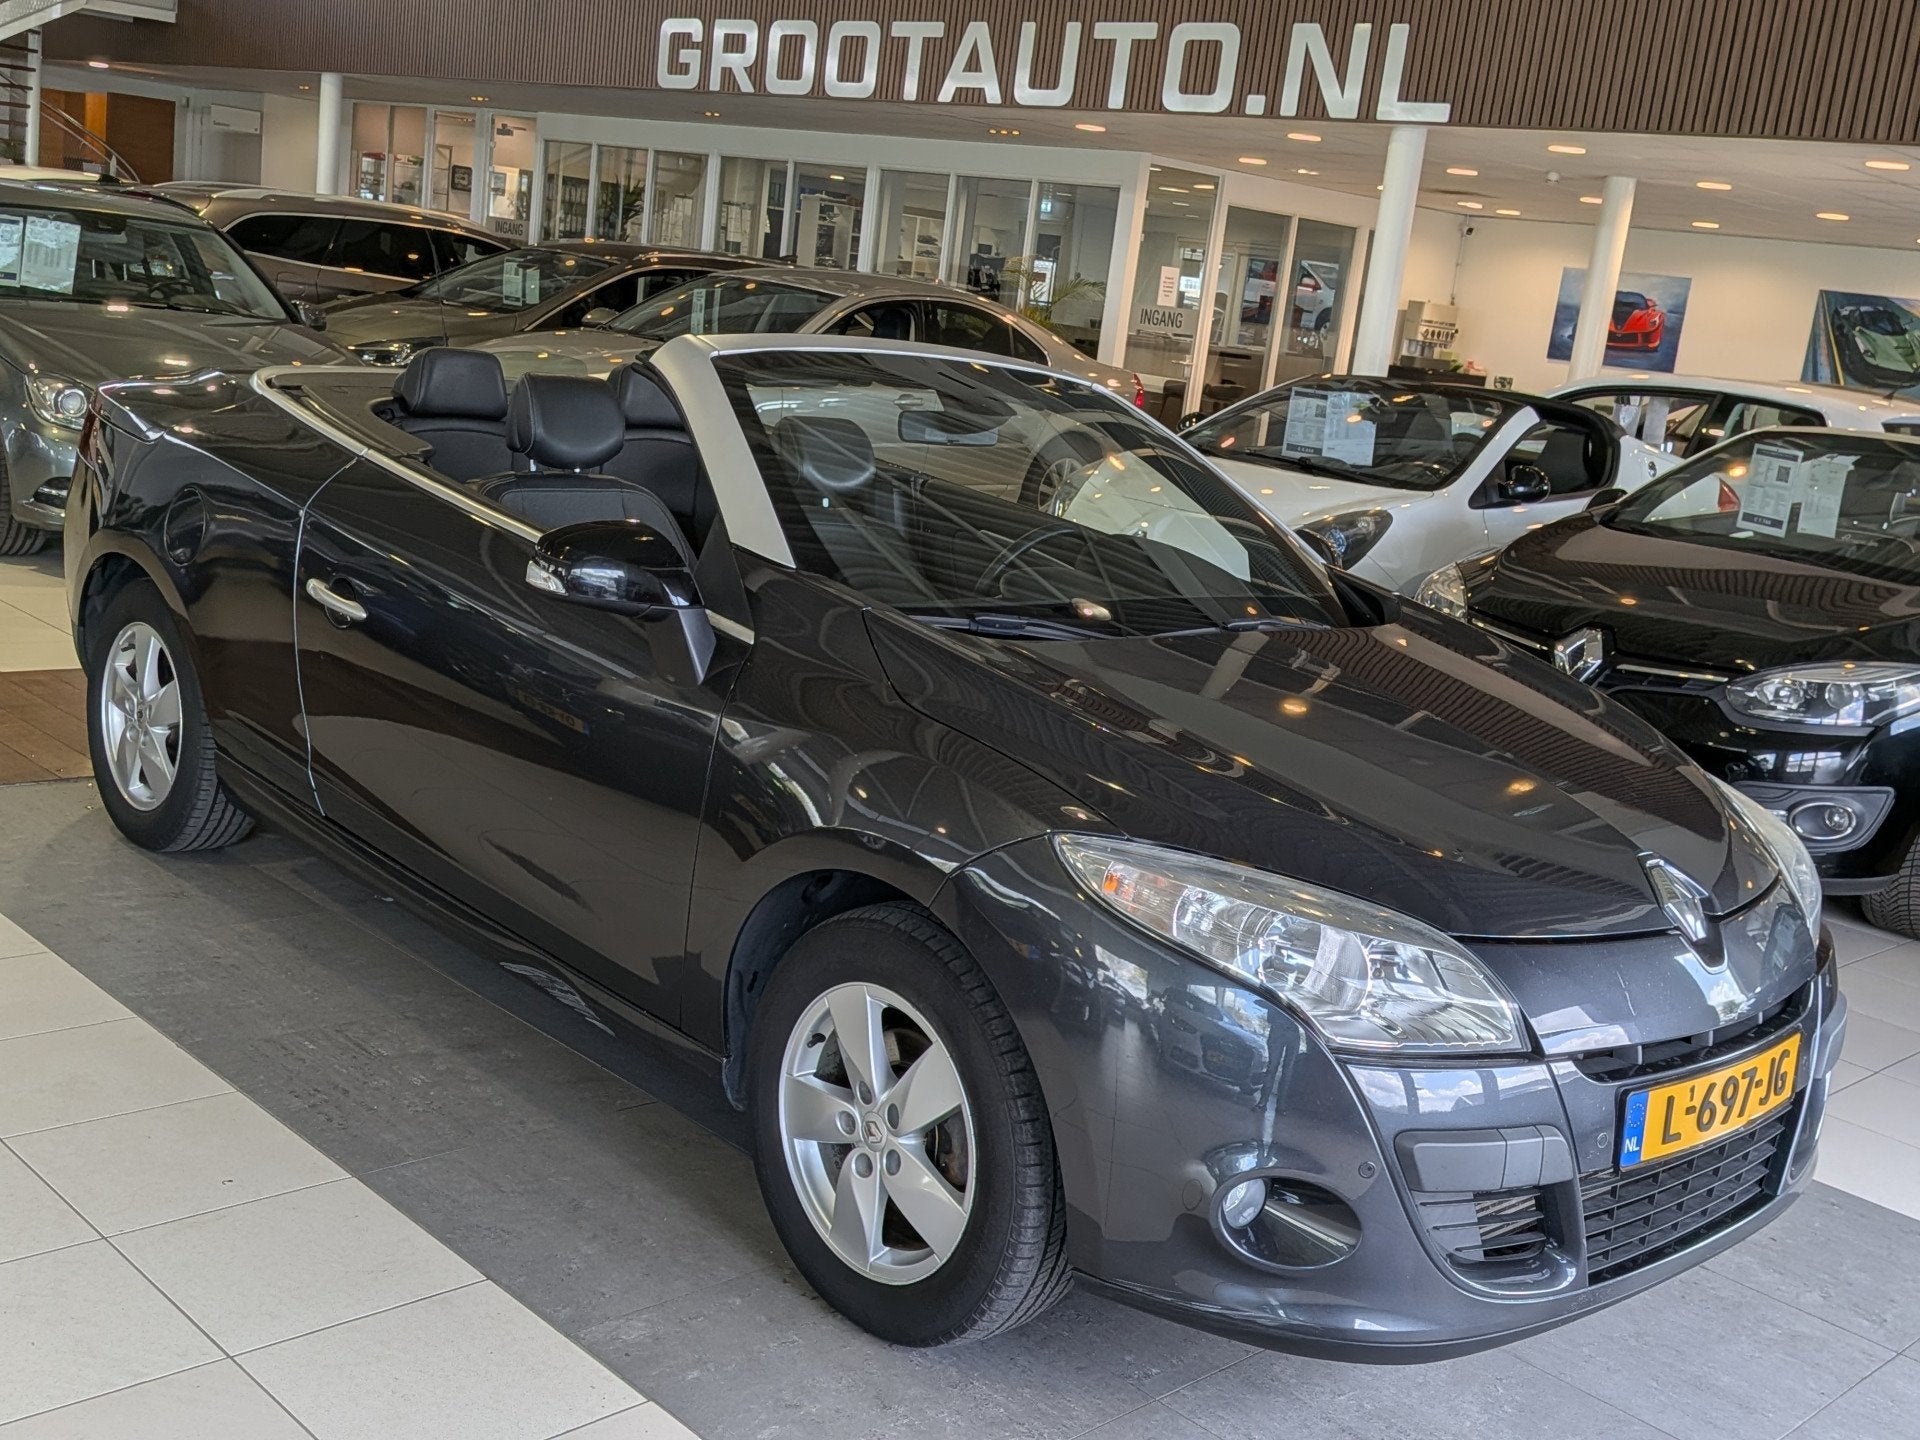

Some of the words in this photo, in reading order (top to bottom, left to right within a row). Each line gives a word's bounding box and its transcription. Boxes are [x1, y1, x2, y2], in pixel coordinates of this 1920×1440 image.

[658, 18, 1451, 124] GROOTAUTO.NL
[494, 220, 524, 236] INGANG
[1140, 308, 1183, 328] INGANG
[1661, 1049, 1791, 1145] L-697-JG
[1624, 1136, 1640, 1154] NL
